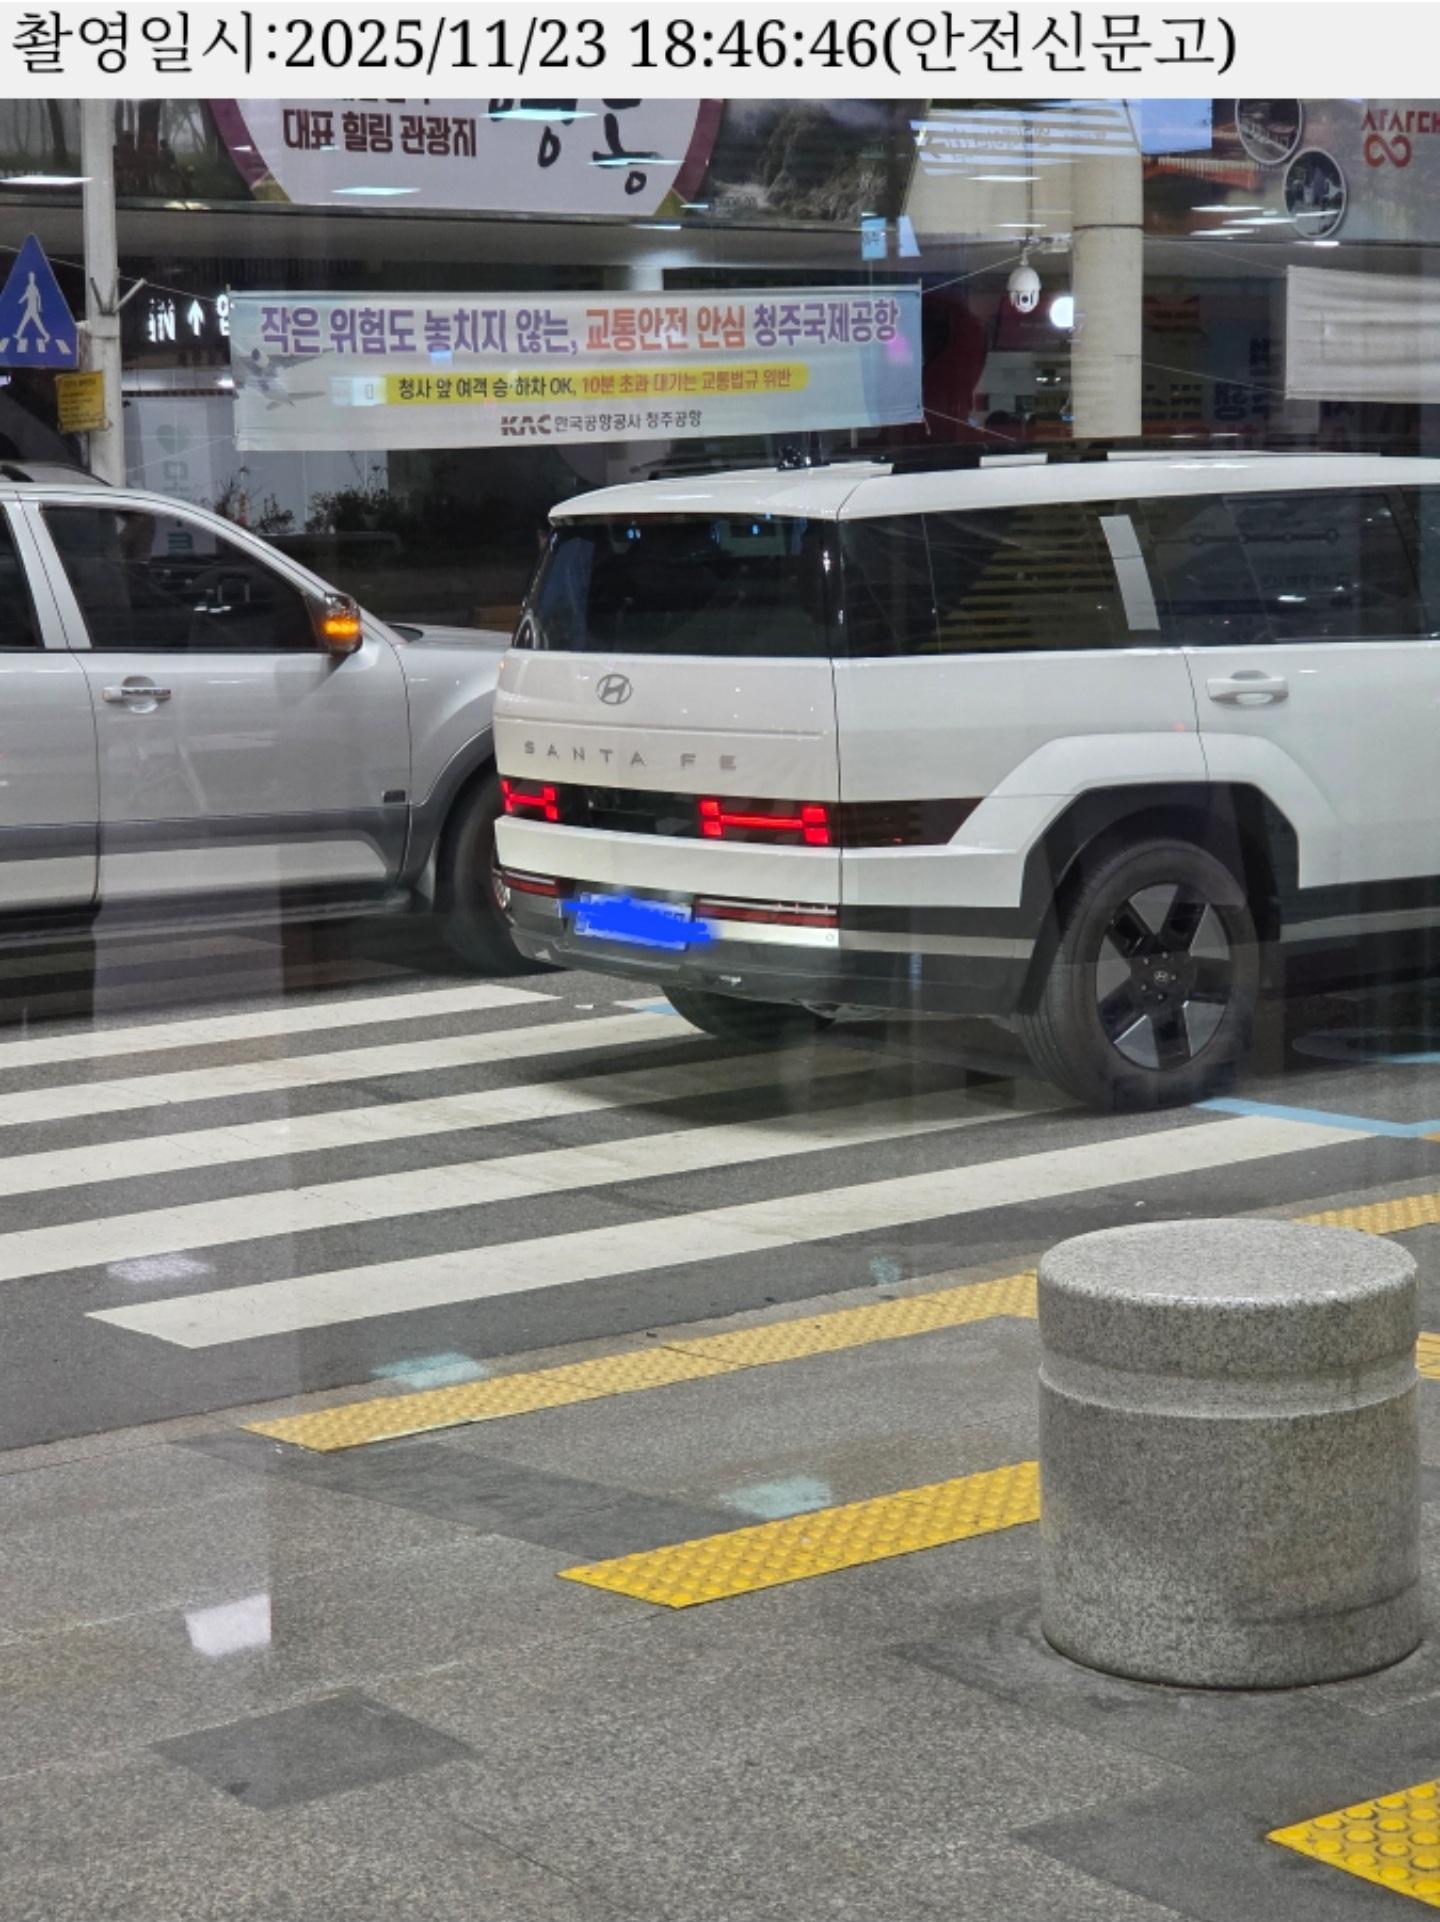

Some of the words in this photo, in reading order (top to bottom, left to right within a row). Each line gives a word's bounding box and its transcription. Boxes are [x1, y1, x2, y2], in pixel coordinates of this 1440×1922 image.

[283, 109, 334, 150] 대표
[341, 111, 393, 153] 힐링
[399, 114, 476, 157] 관광지
[261, 307, 321, 353] 작은
[330, 308, 417, 354] 위험도
[424, 308, 508, 353] 놓치지
[516, 309, 577, 355] 않는,
[586, 307, 689, 352] 교통안전
[697, 305, 746, 349] 안심
[753, 300, 898, 346] 청주국제공항
[399, 377, 432, 400] 청사
[436, 379, 452, 399] 앞
[456, 377, 488, 398] 여객
[550, 377, 577, 396] OK,
[582, 374, 615, 394] 10분
[619, 373, 649, 393] 초과
[653, 372, 696, 392] 대기는
[702, 369, 759, 391] 교통법규
[763, 368, 792, 388] 위반
[501, 414, 551, 436] KAC
[555, 413, 641, 433] 한국공항공사
[646, 409, 703, 429] 청주공항
[524, 740, 647, 767] SANTA
[680, 752, 737, 771] FE
